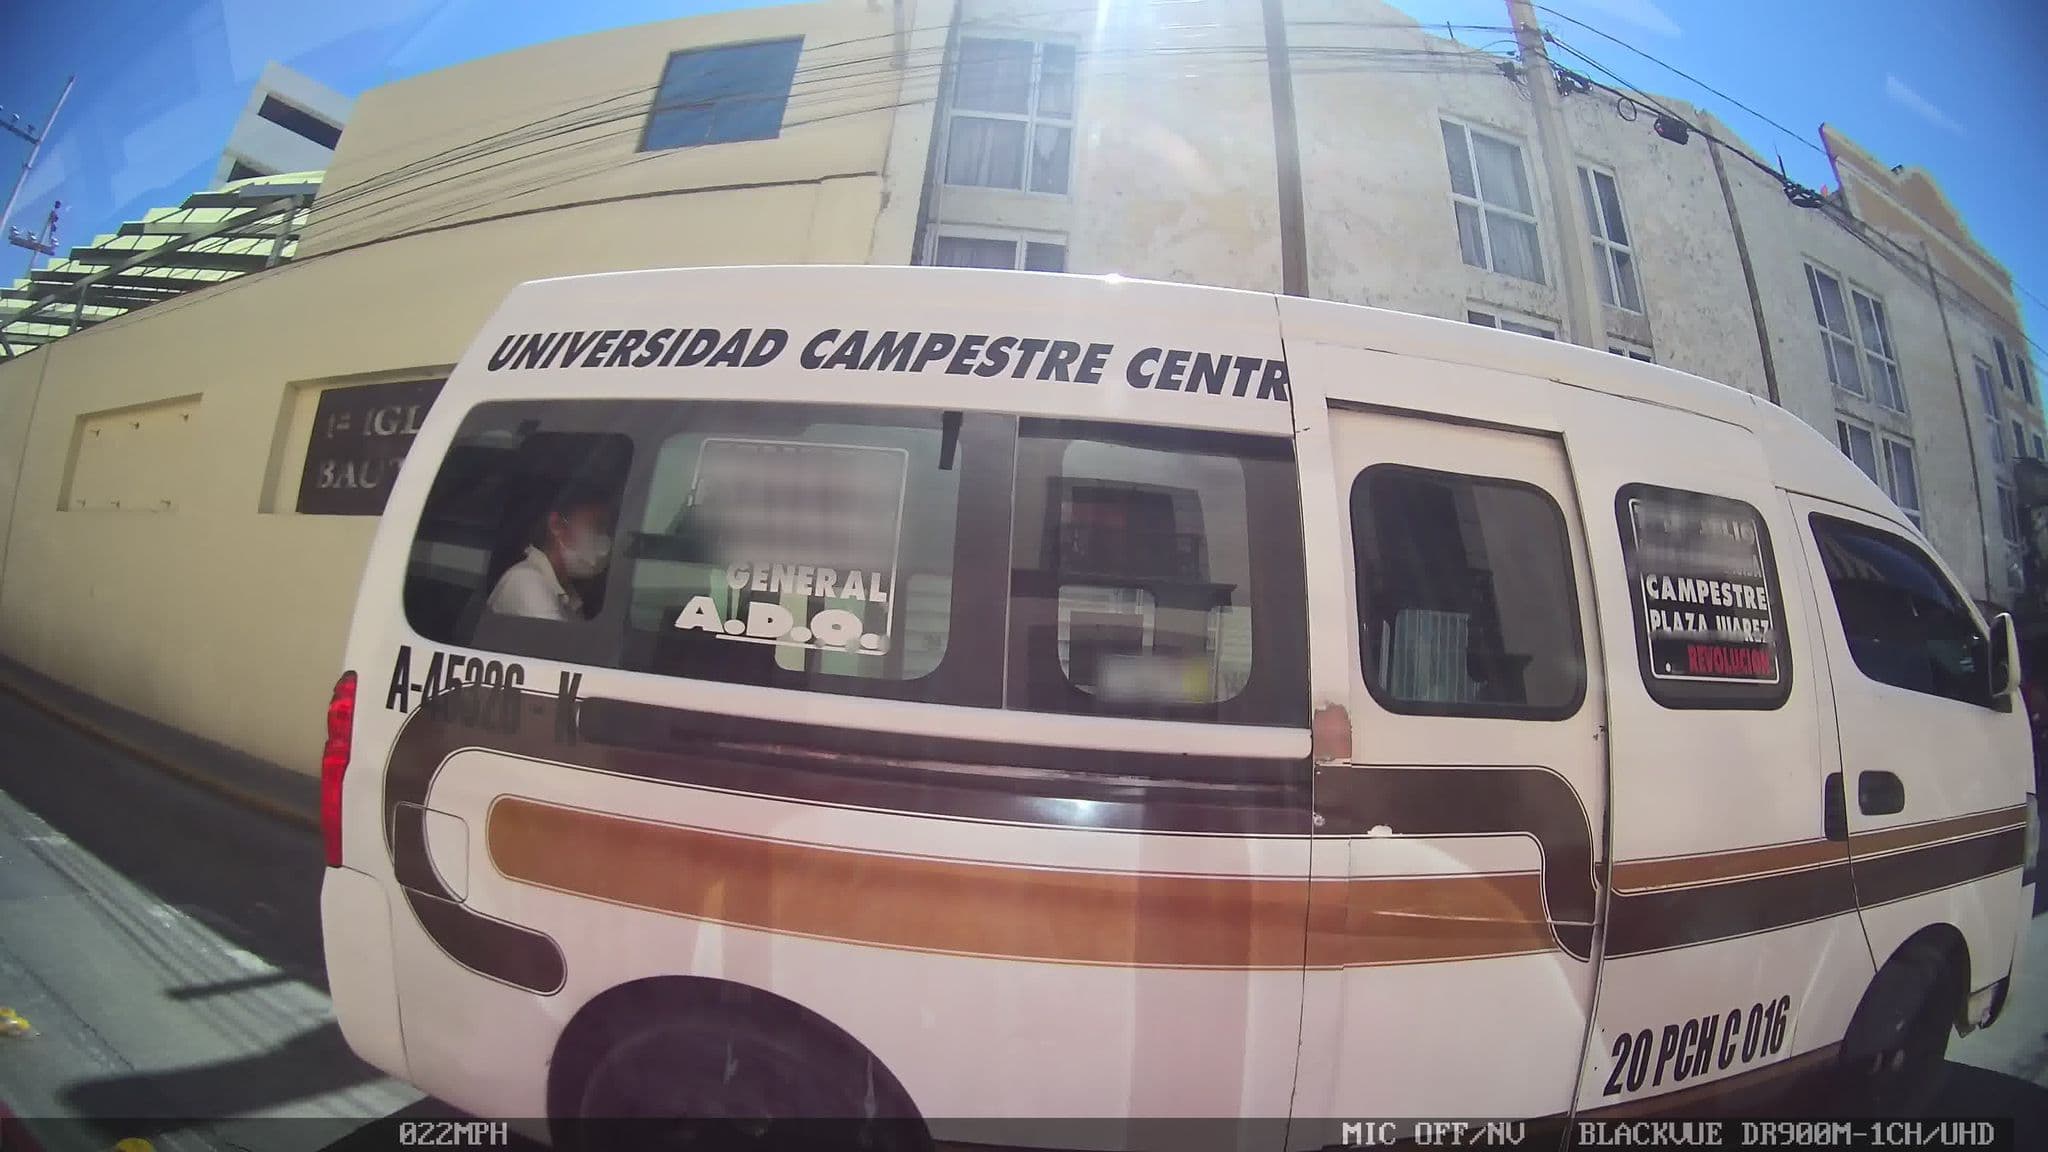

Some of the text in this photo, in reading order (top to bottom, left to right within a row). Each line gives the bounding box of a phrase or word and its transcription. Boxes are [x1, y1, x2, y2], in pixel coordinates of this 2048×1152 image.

[487, 328, 1289, 401] UNIVERSIDAD CAMPESTRE CENTR
[726, 560, 888, 602] GENERAL
[1645, 573, 1768, 611] CAMPESTRE
[674, 595, 883, 650] A.D.O.
[1649, 608, 1709, 633] PLAZA
[1603, 994, 1791, 1097] 20 PCH C 016
